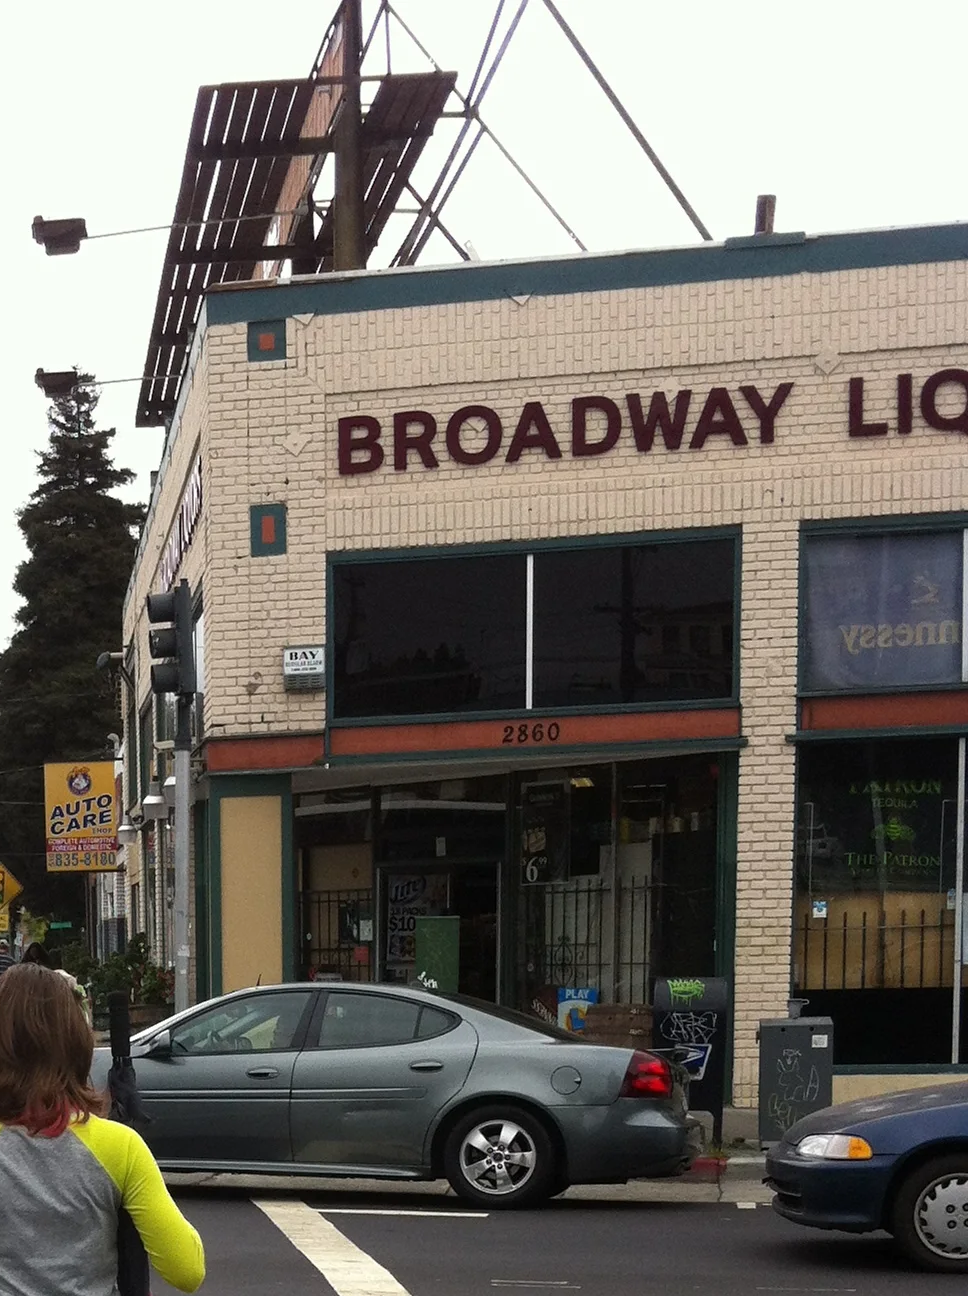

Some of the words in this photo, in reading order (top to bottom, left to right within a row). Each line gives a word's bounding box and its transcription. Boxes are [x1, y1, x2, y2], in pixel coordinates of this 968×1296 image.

[337, 381, 795, 476] BROADWAY
[848, 368, 968, 438] LIQ
[289, 650, 319, 660] BAY
[502, 721, 560, 744] 2860
[50, 794, 113, 821] AUTO
[872, 797, 919, 809] TEQUILA
[50, 809, 113, 835] CARE
[48, 838, 78, 846] COMPLETE
[79, 836, 115, 845] AUTOMOTIVE
[51, 844, 77, 852] FOREIGN
[82, 843, 112, 851] DOMESTIC
[55, 851, 117, 867] 835-8180
[844, 851, 877, 866] THE
[389, 916, 416, 932] $10
[564, 987, 590, 999] PLAY
